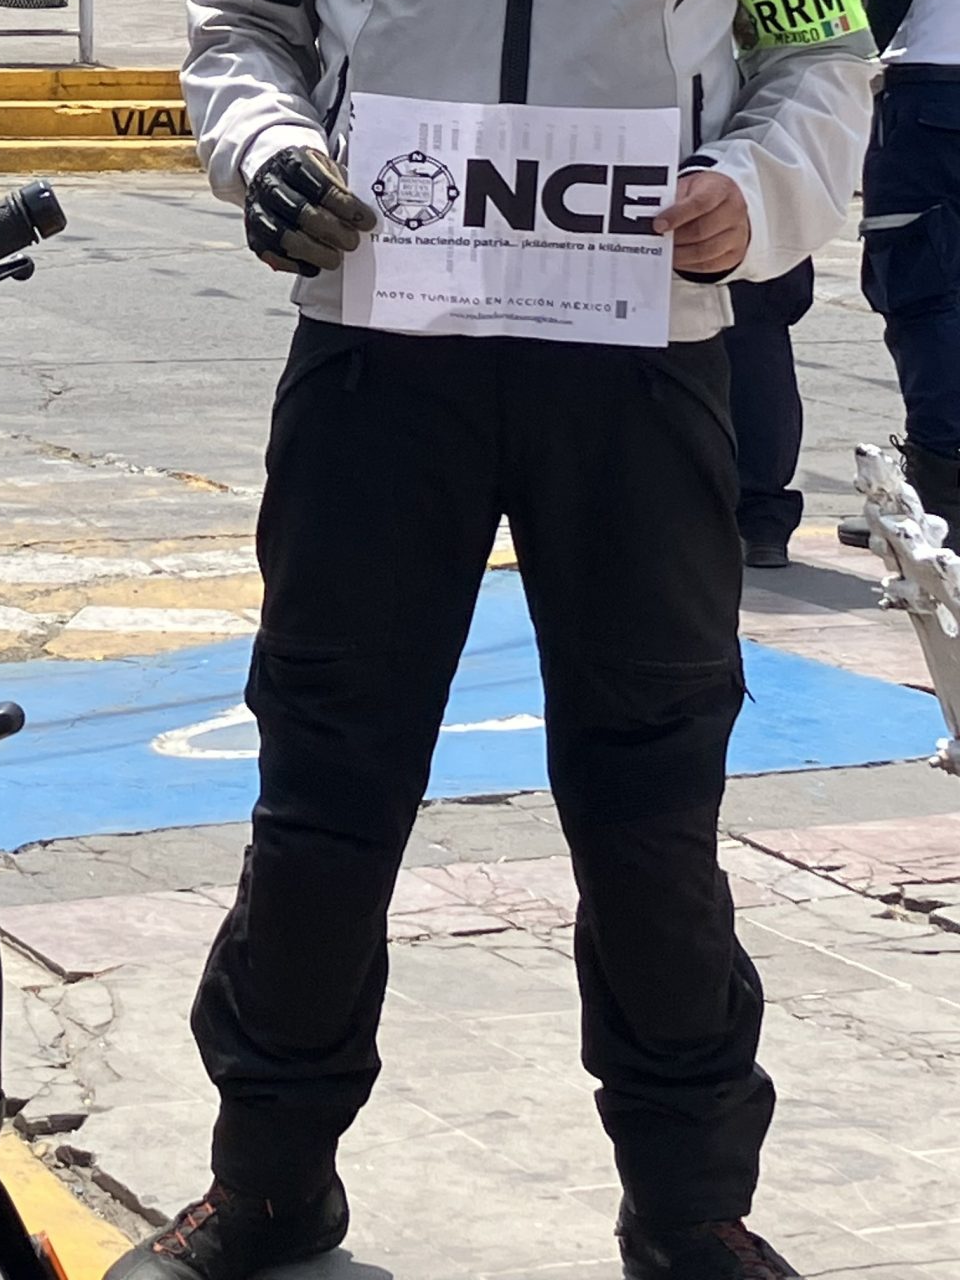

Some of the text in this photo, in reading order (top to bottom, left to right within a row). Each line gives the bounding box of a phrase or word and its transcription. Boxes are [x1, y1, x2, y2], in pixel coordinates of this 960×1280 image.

[382, 234, 412, 245] años
[415, 236, 470, 247] haciendo
[587, 243, 595, 251] a
[376, 290, 415, 300] MOTO
[420, 293, 480, 305] TURISMO
[485, 296, 502, 305] EN
